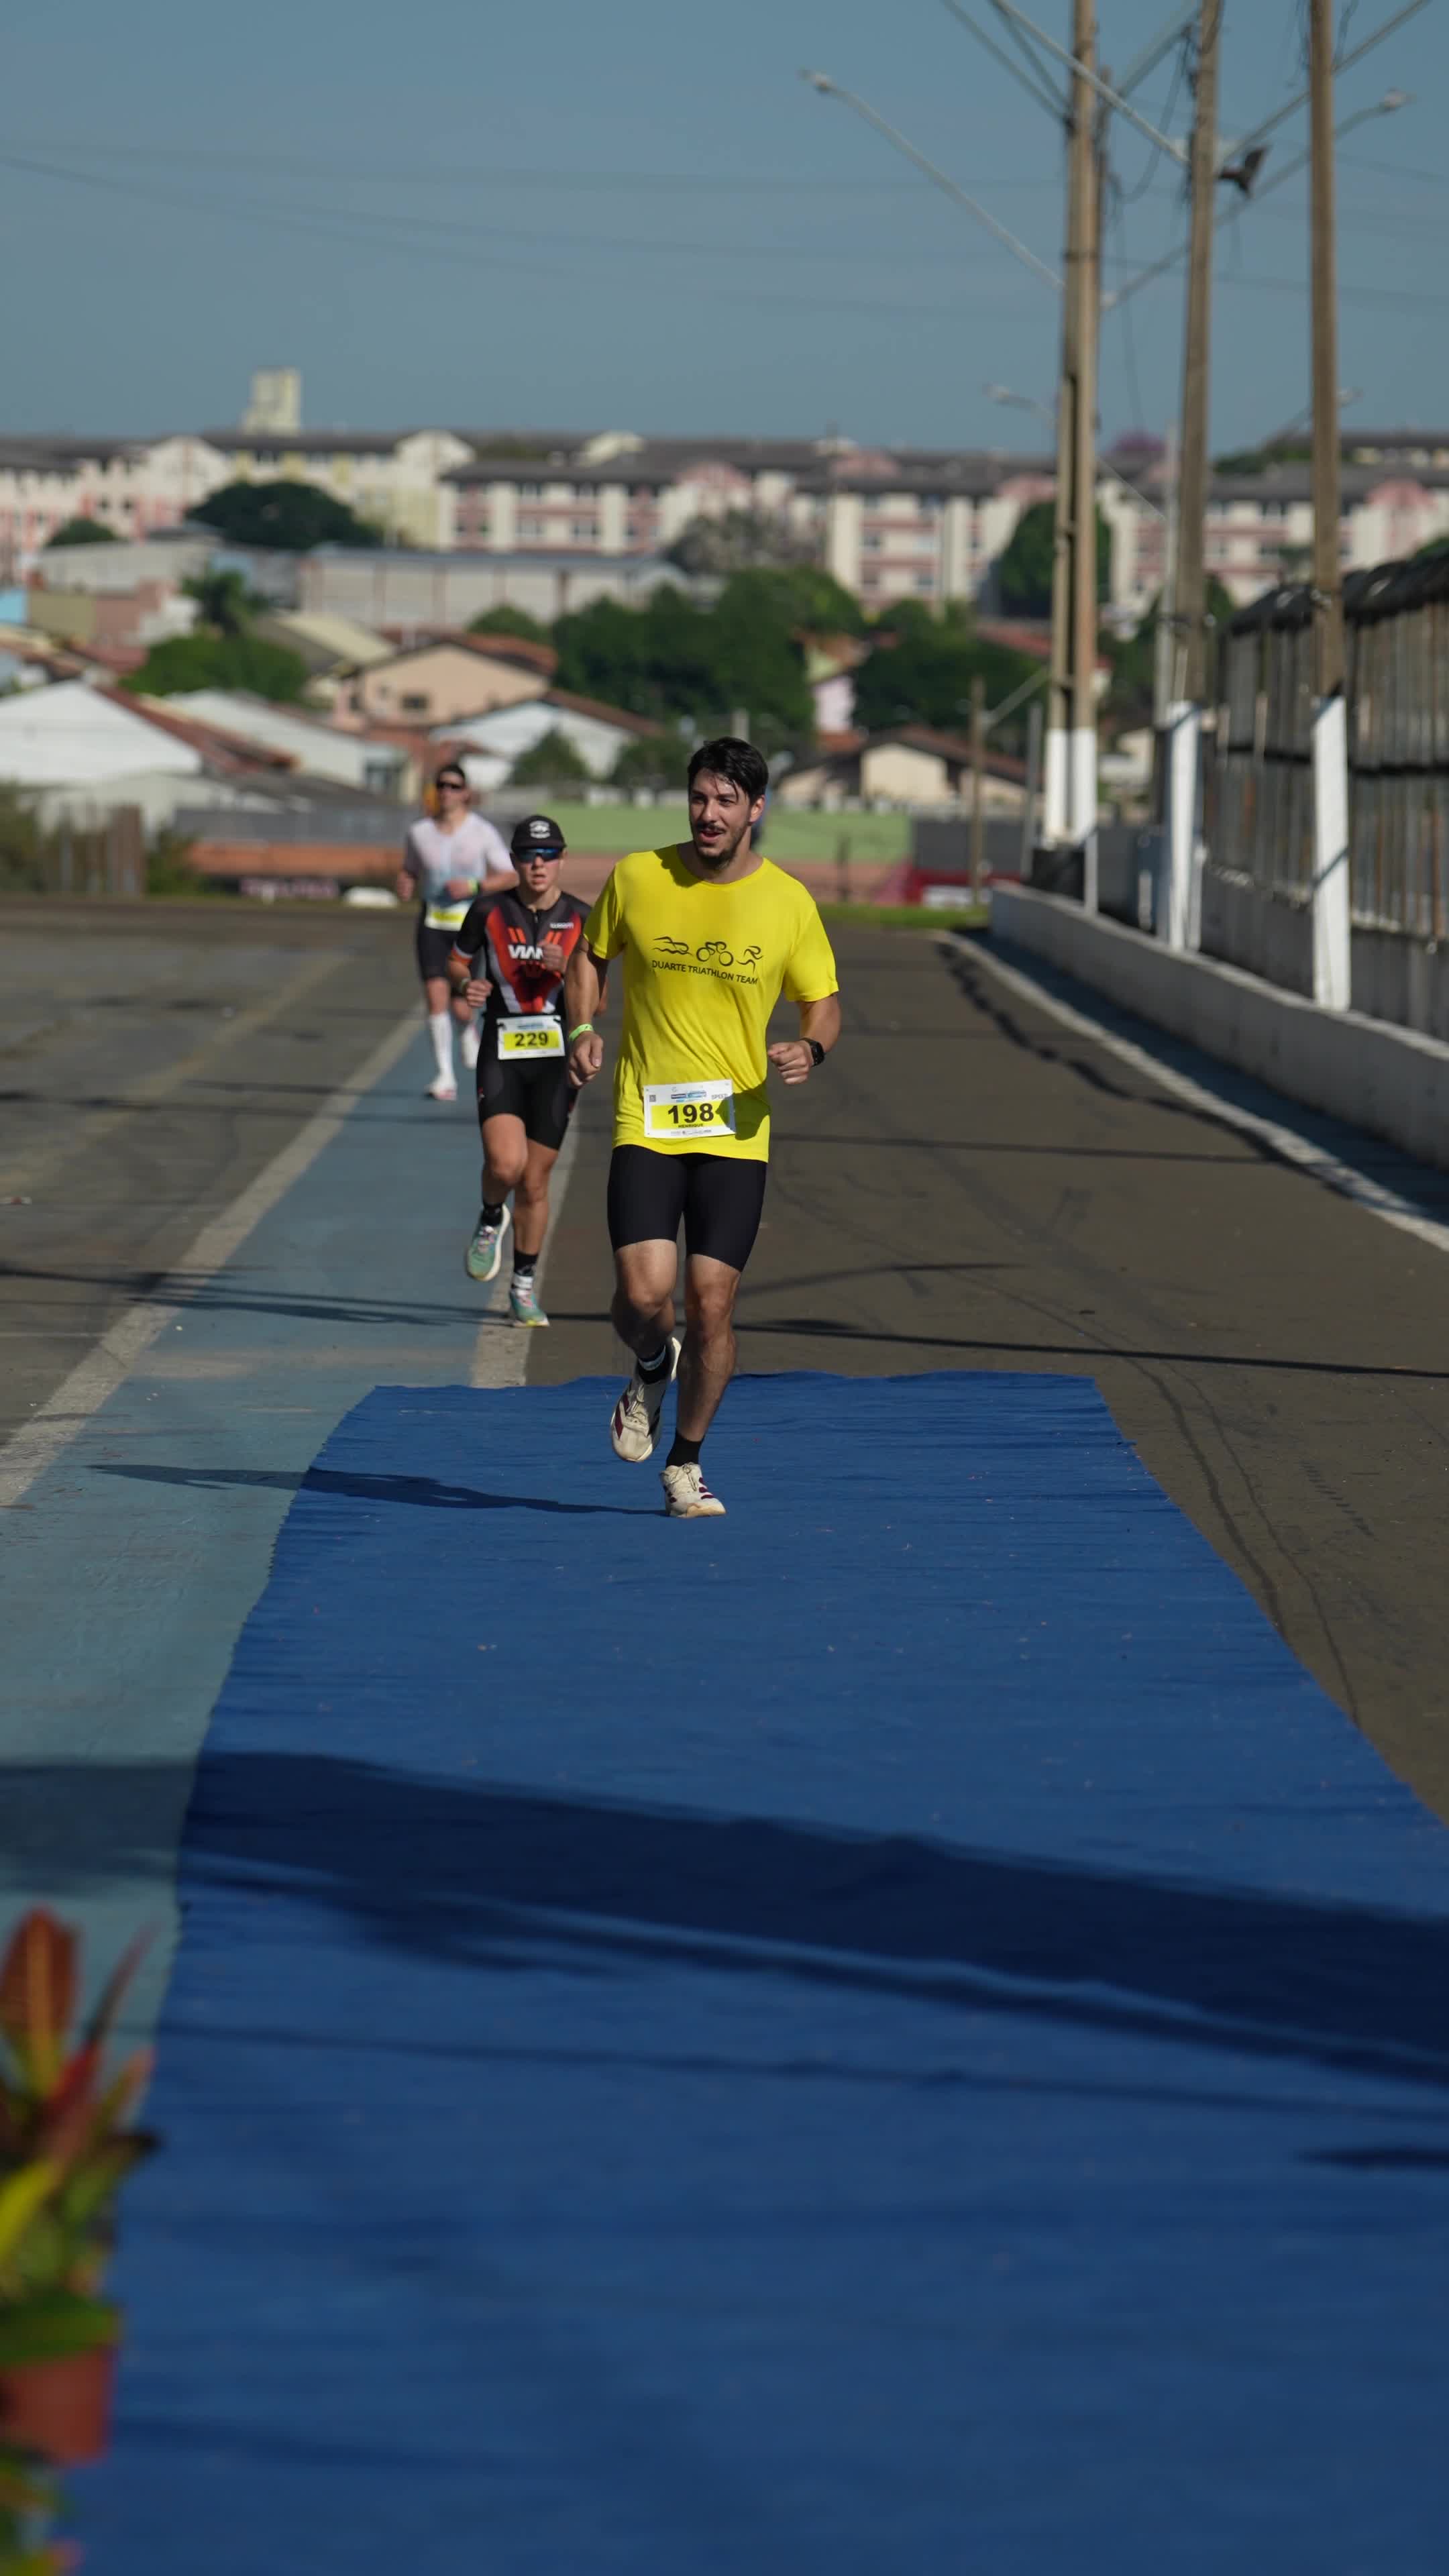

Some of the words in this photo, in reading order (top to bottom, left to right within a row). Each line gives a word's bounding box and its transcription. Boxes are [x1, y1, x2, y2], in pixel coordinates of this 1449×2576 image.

[651, 960, 686, 972] DUARTE
[688, 965, 734, 981] TRIATHLON
[736, 974, 758, 985] TEAM
[515, 1032, 548, 1046] 229
[668, 1103, 714, 1124] 198
